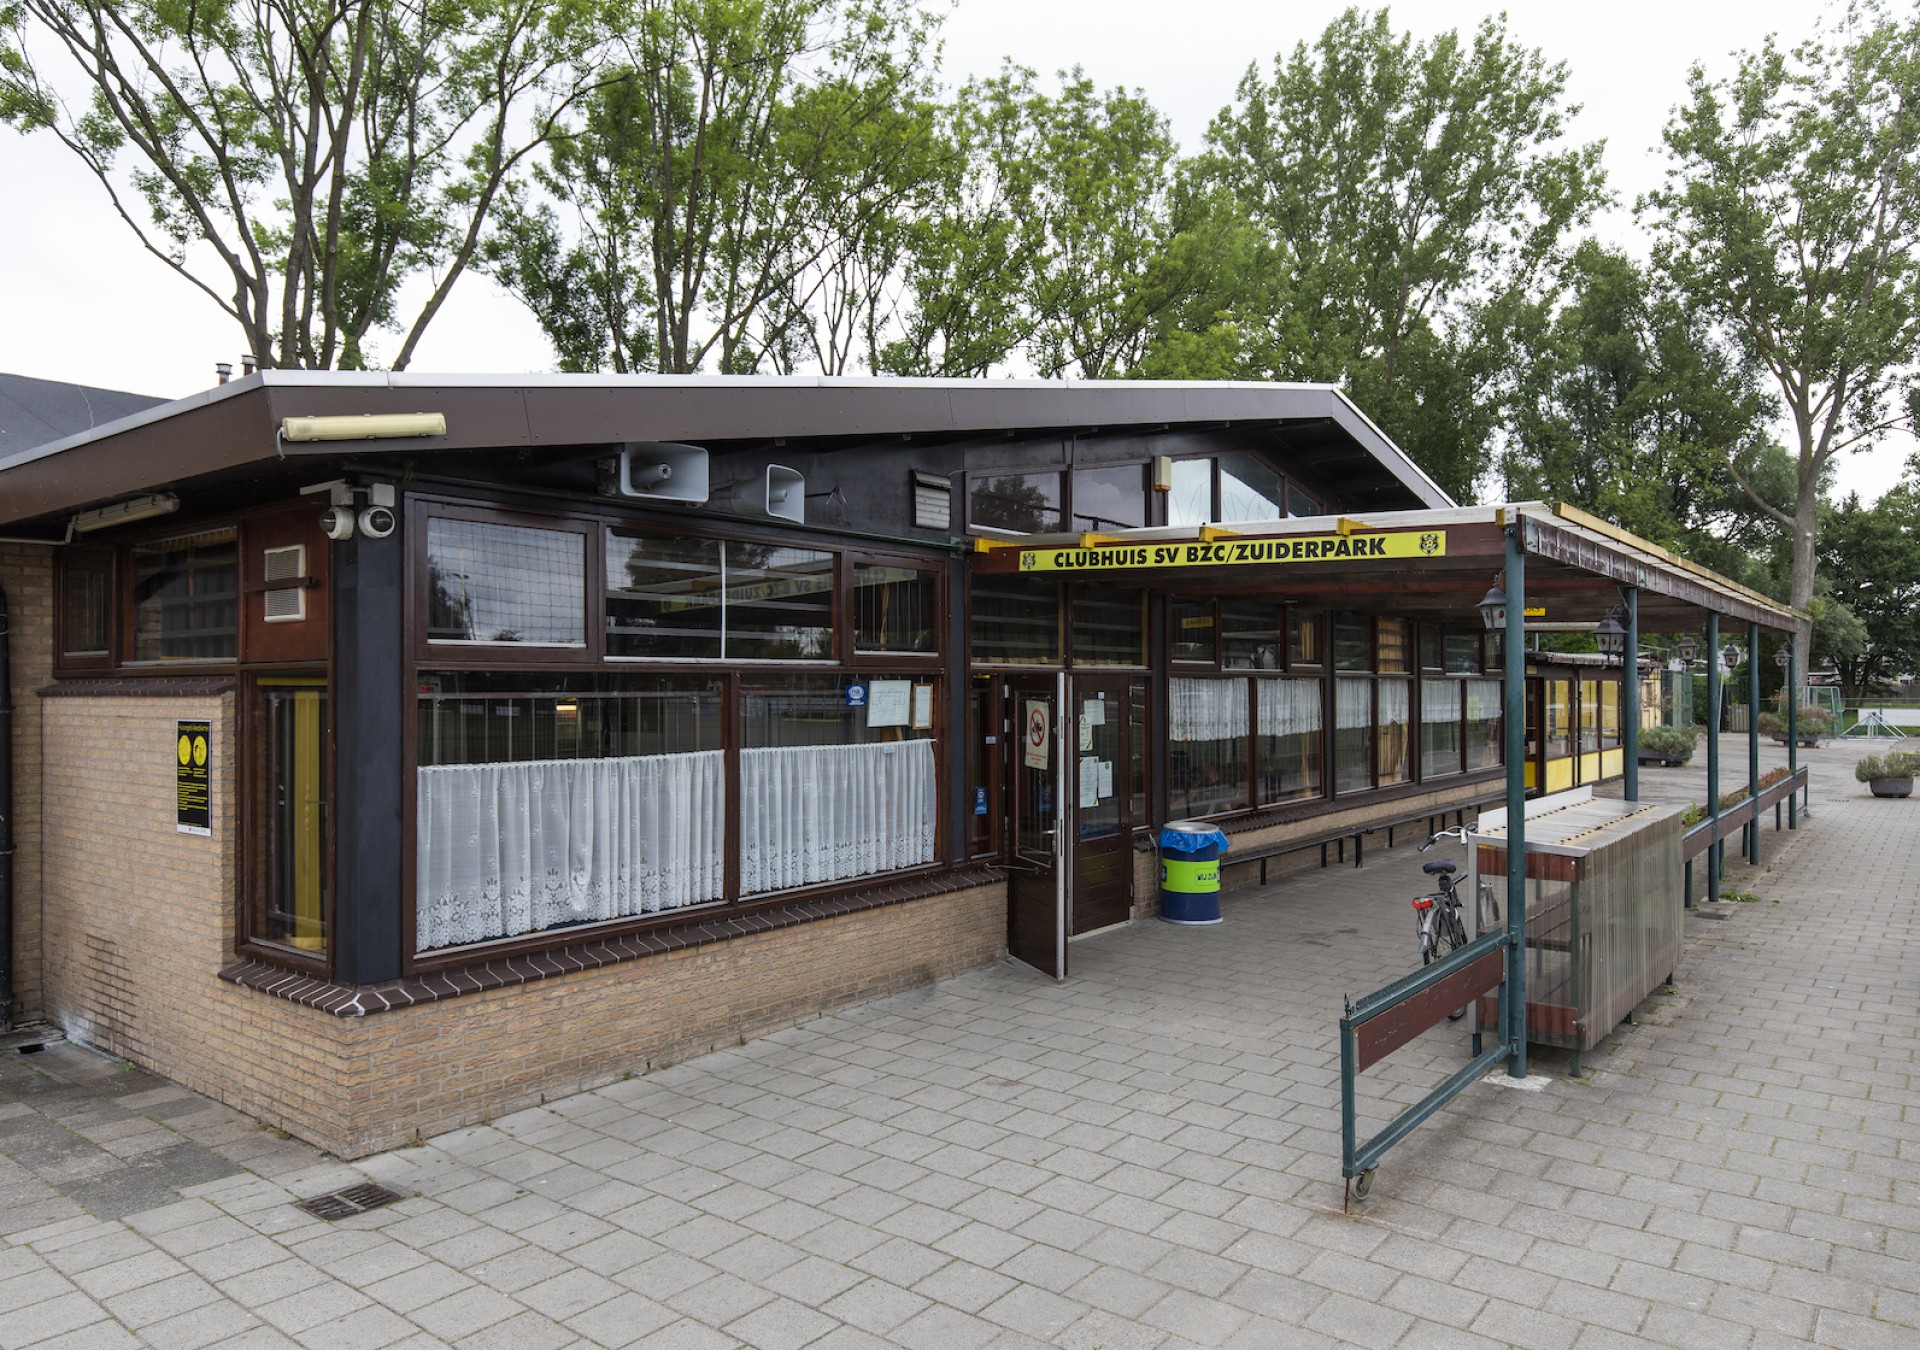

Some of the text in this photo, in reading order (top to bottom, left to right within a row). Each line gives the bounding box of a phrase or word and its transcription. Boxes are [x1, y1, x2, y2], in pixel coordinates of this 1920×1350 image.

[1054, 537, 1387, 568] CLUBHUIS SV BZC/ZUIDERPARK
